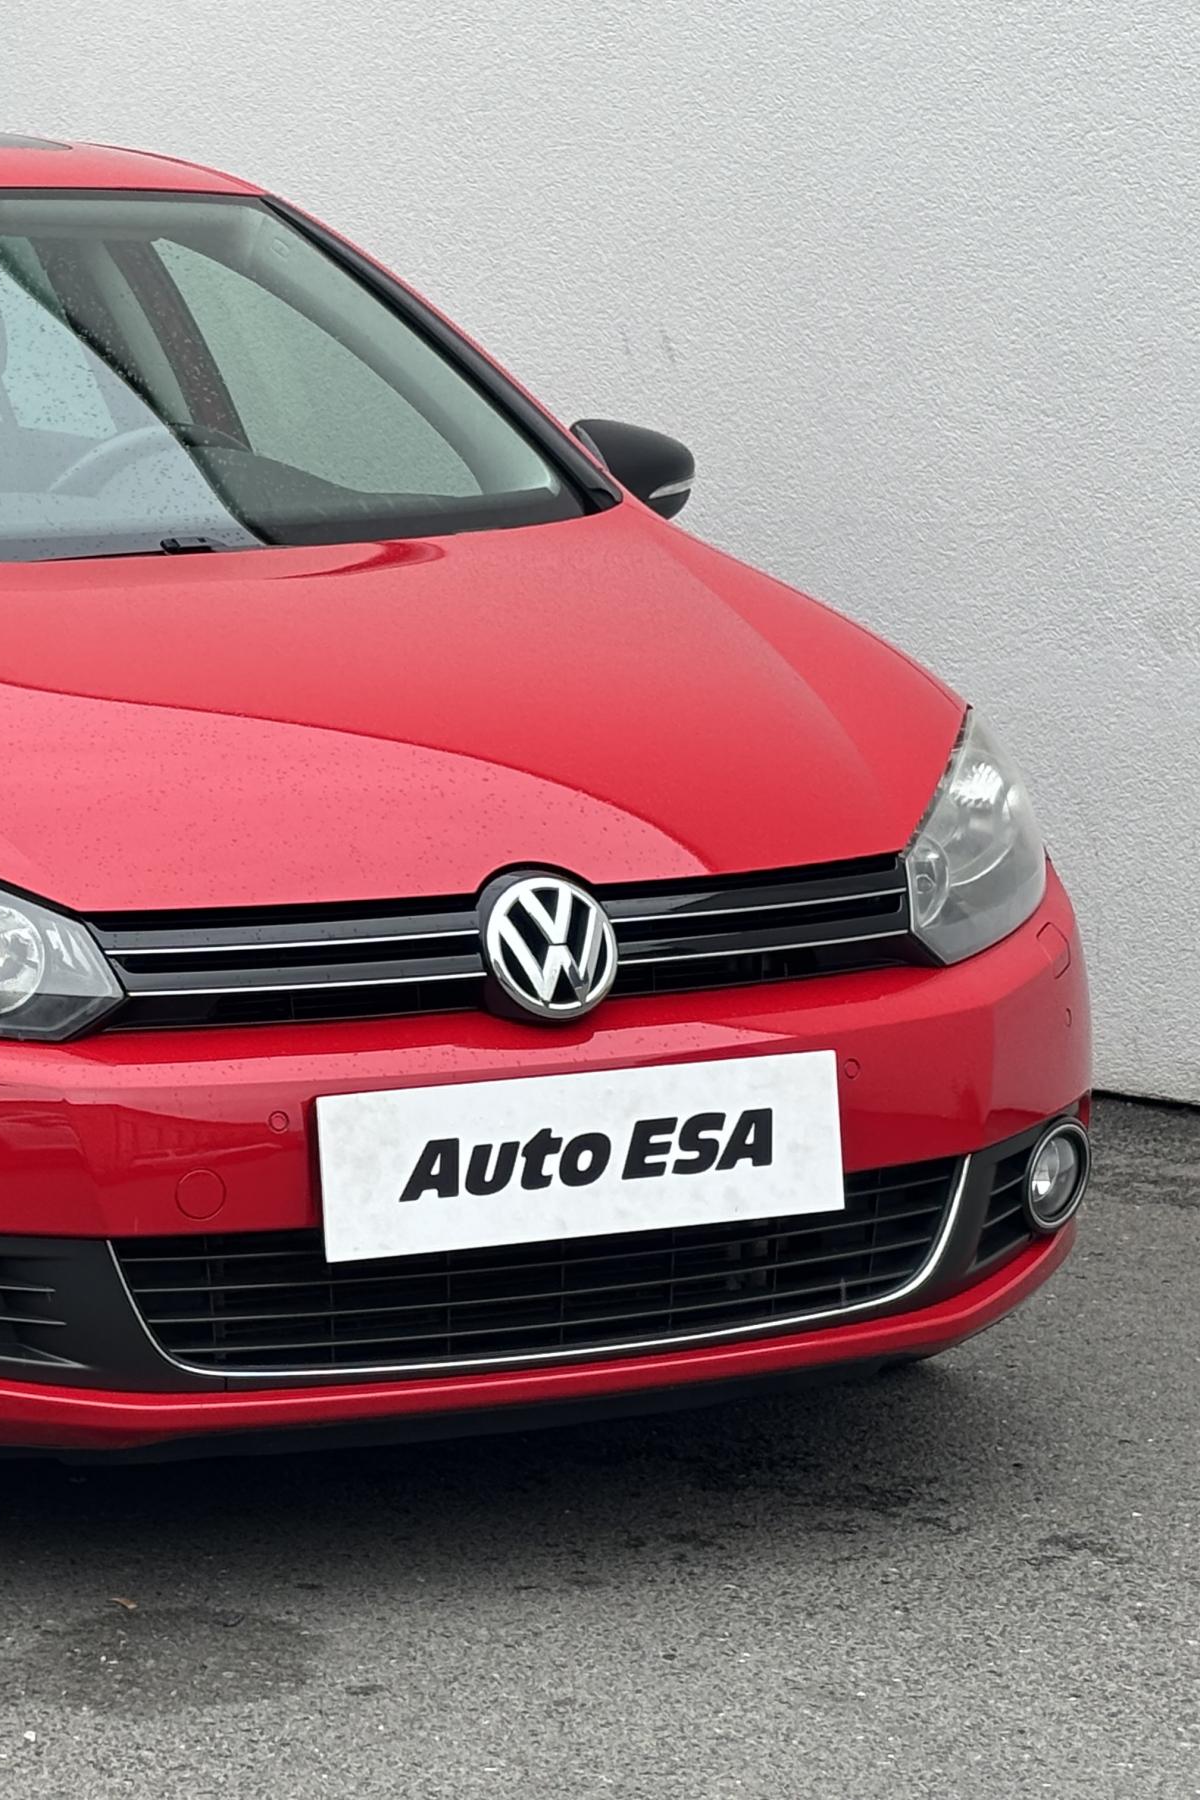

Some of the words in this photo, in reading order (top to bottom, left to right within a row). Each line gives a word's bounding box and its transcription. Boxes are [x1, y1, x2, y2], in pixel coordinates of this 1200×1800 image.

[494, 880, 608, 1009] VW
[399, 1127, 612, 1202] Auto
[621, 1107, 773, 1180] ESA
